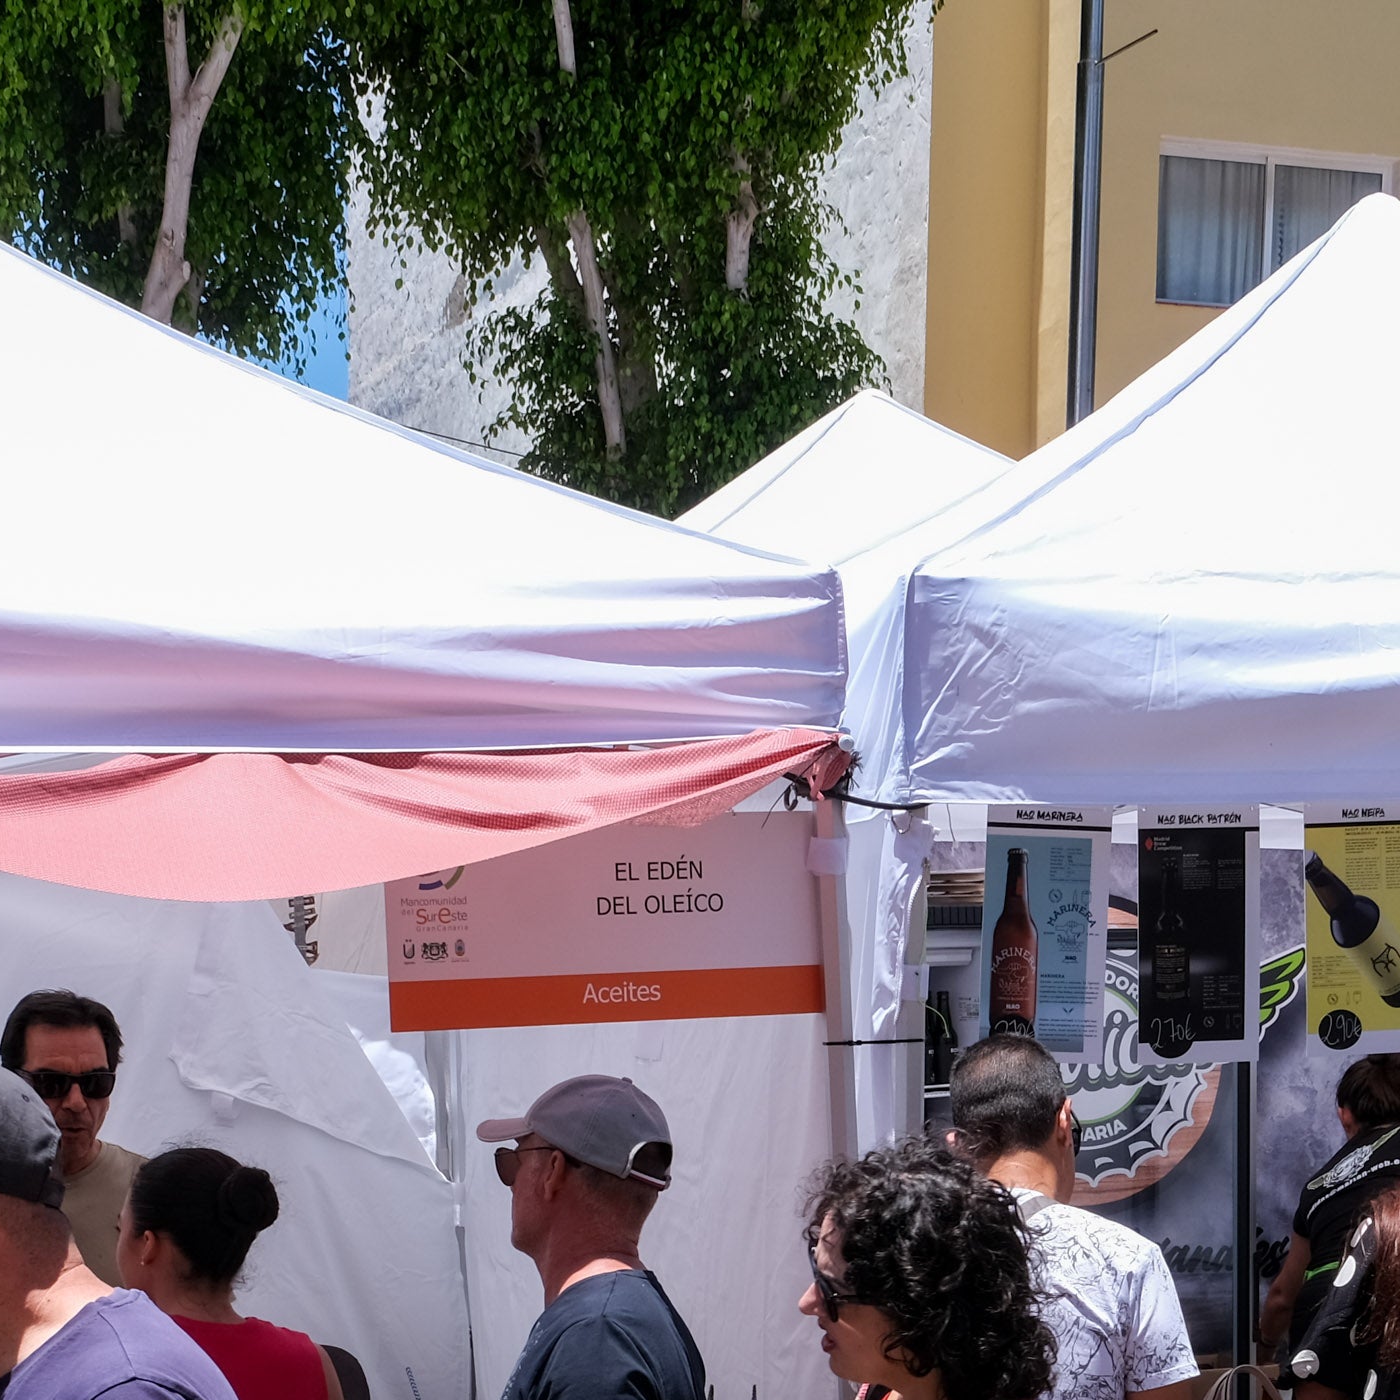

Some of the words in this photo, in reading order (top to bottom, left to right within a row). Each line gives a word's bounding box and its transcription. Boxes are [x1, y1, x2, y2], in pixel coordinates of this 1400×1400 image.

[1016, 810, 1035, 820] NAO
[1037, 811, 1083, 822] MARINERA
[1158, 815, 1176, 824] NAO
[1178, 814, 1204, 824] BLACK
[615, 862, 640, 881] EL
[647, 854, 703, 880] EDÉN
[400, 896, 467, 906] Mancomunidad
[597, 896, 637, 916] DEL
[644, 888, 724, 914] OLEÍCO
[1047, 904, 1096, 928] MARINERA
[583, 980, 661, 1004] Aceites
